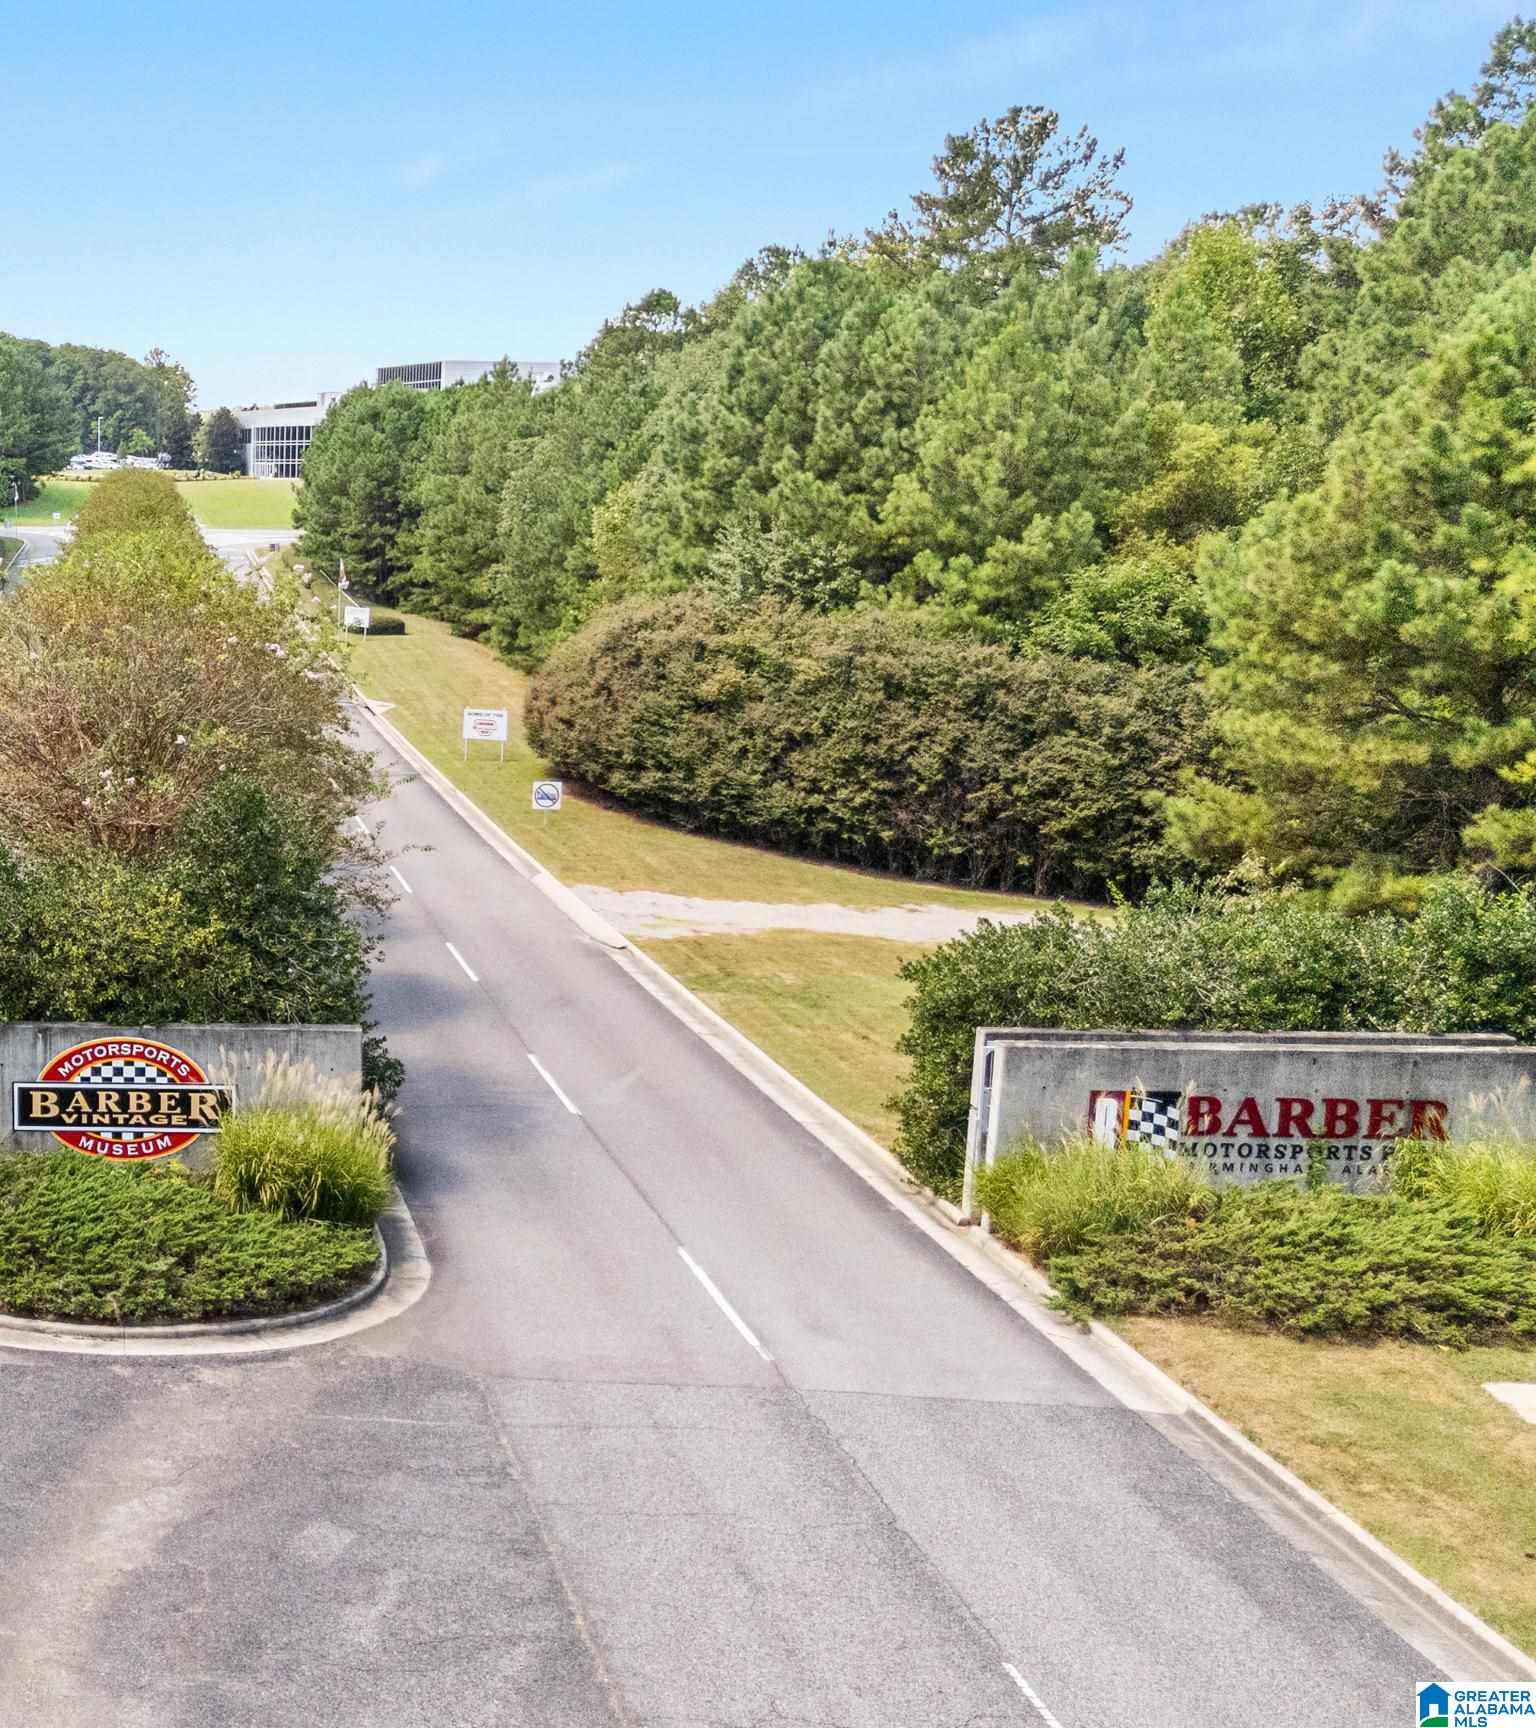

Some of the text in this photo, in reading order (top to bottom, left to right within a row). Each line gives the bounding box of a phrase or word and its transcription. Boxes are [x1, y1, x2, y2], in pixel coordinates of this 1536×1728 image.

[57, 1043, 191, 1077] MOTORSPORTS
[29, 1090, 222, 1127] BARBER
[61, 1113, 189, 1126] VINTAGE
[1182, 1096, 1449, 1142] BARBER
[78, 1135, 173, 1156] MUSEUM
